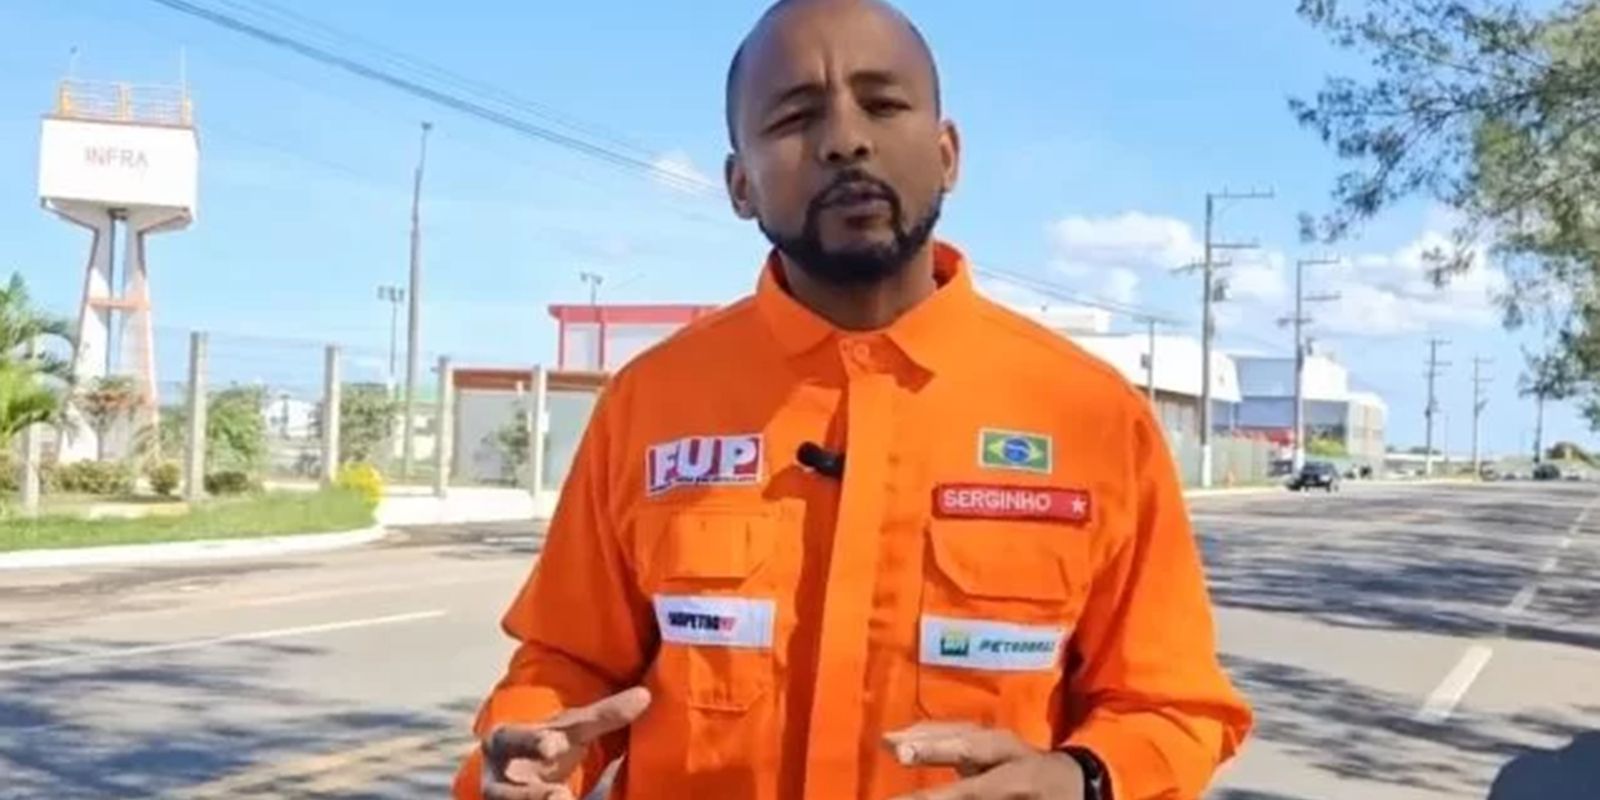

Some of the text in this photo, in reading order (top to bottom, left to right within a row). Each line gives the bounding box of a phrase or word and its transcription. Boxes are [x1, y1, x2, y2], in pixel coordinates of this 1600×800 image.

[84, 146, 149, 168] INFRA
[653, 437, 758, 487] FUP
[943, 489, 1051, 511] SERGINHO
